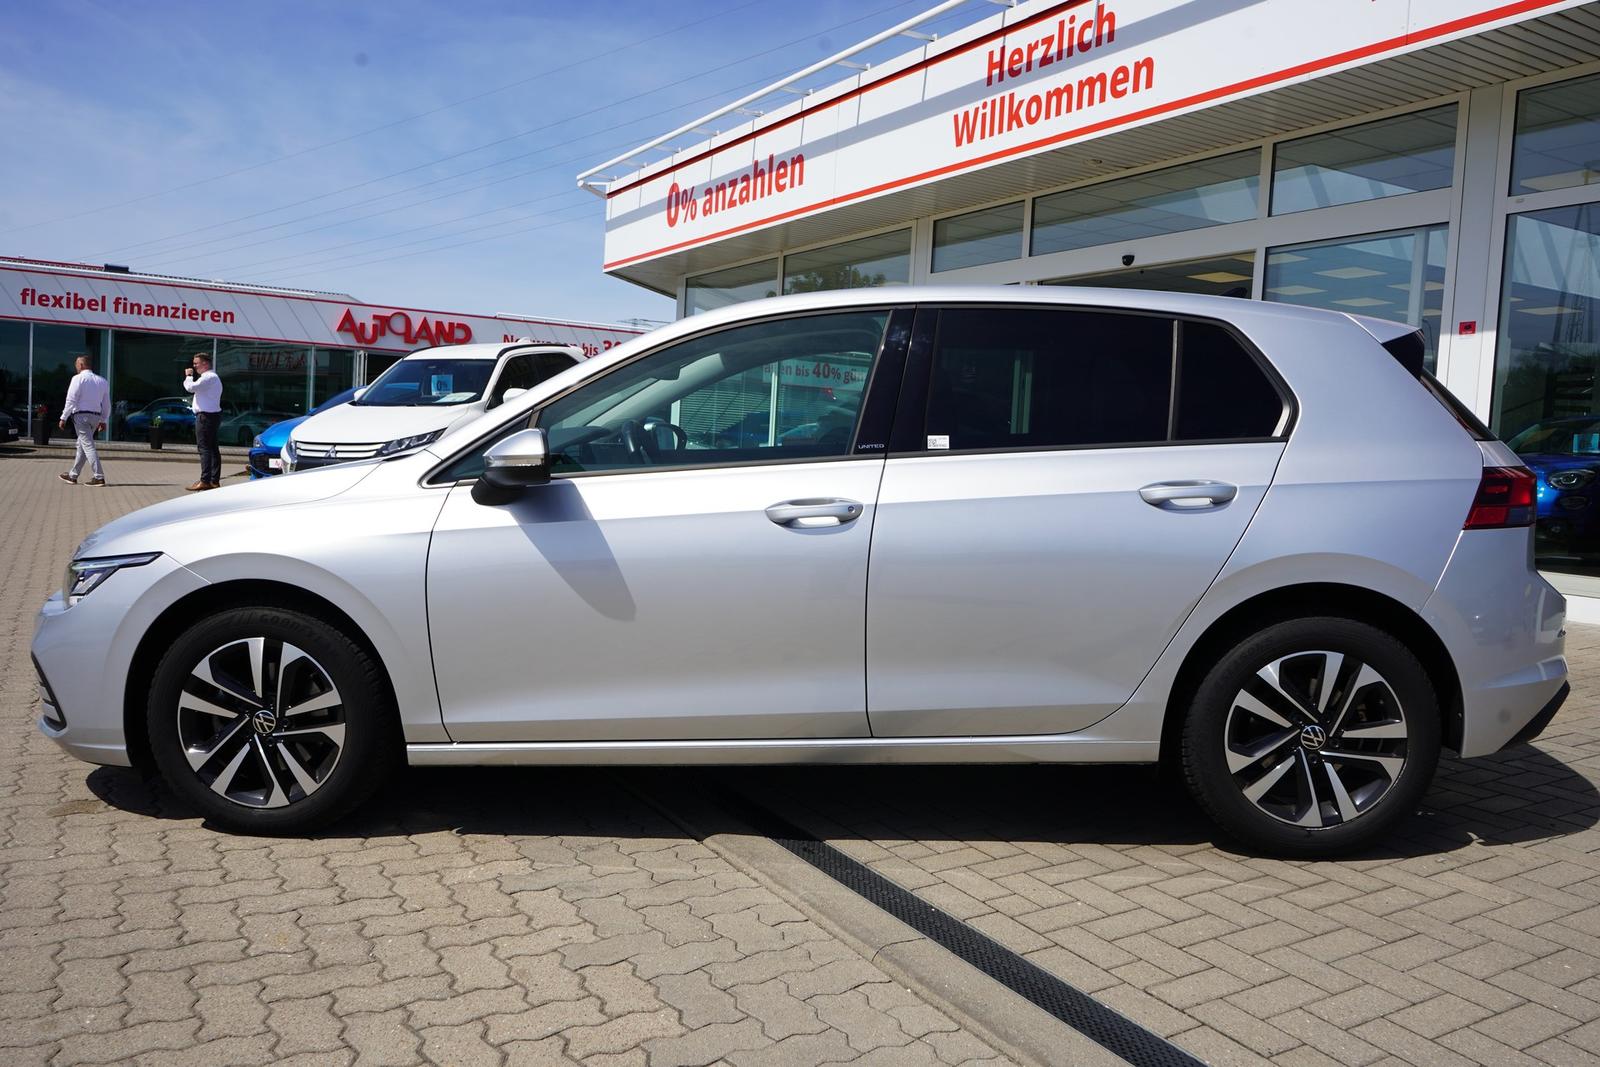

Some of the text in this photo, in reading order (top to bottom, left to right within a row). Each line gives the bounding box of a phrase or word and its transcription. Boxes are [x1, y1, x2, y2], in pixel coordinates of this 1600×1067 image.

[986, 4, 1116, 87] Herzlich
[953, 56, 1154, 148] Willkommen
[666, 153, 805, 228] 0% anzahlen
[20, 288, 235, 324] flexibel finanzieren
[336, 308, 473, 347] AUTOLAND
[812, 361, 842, 381] 40%
